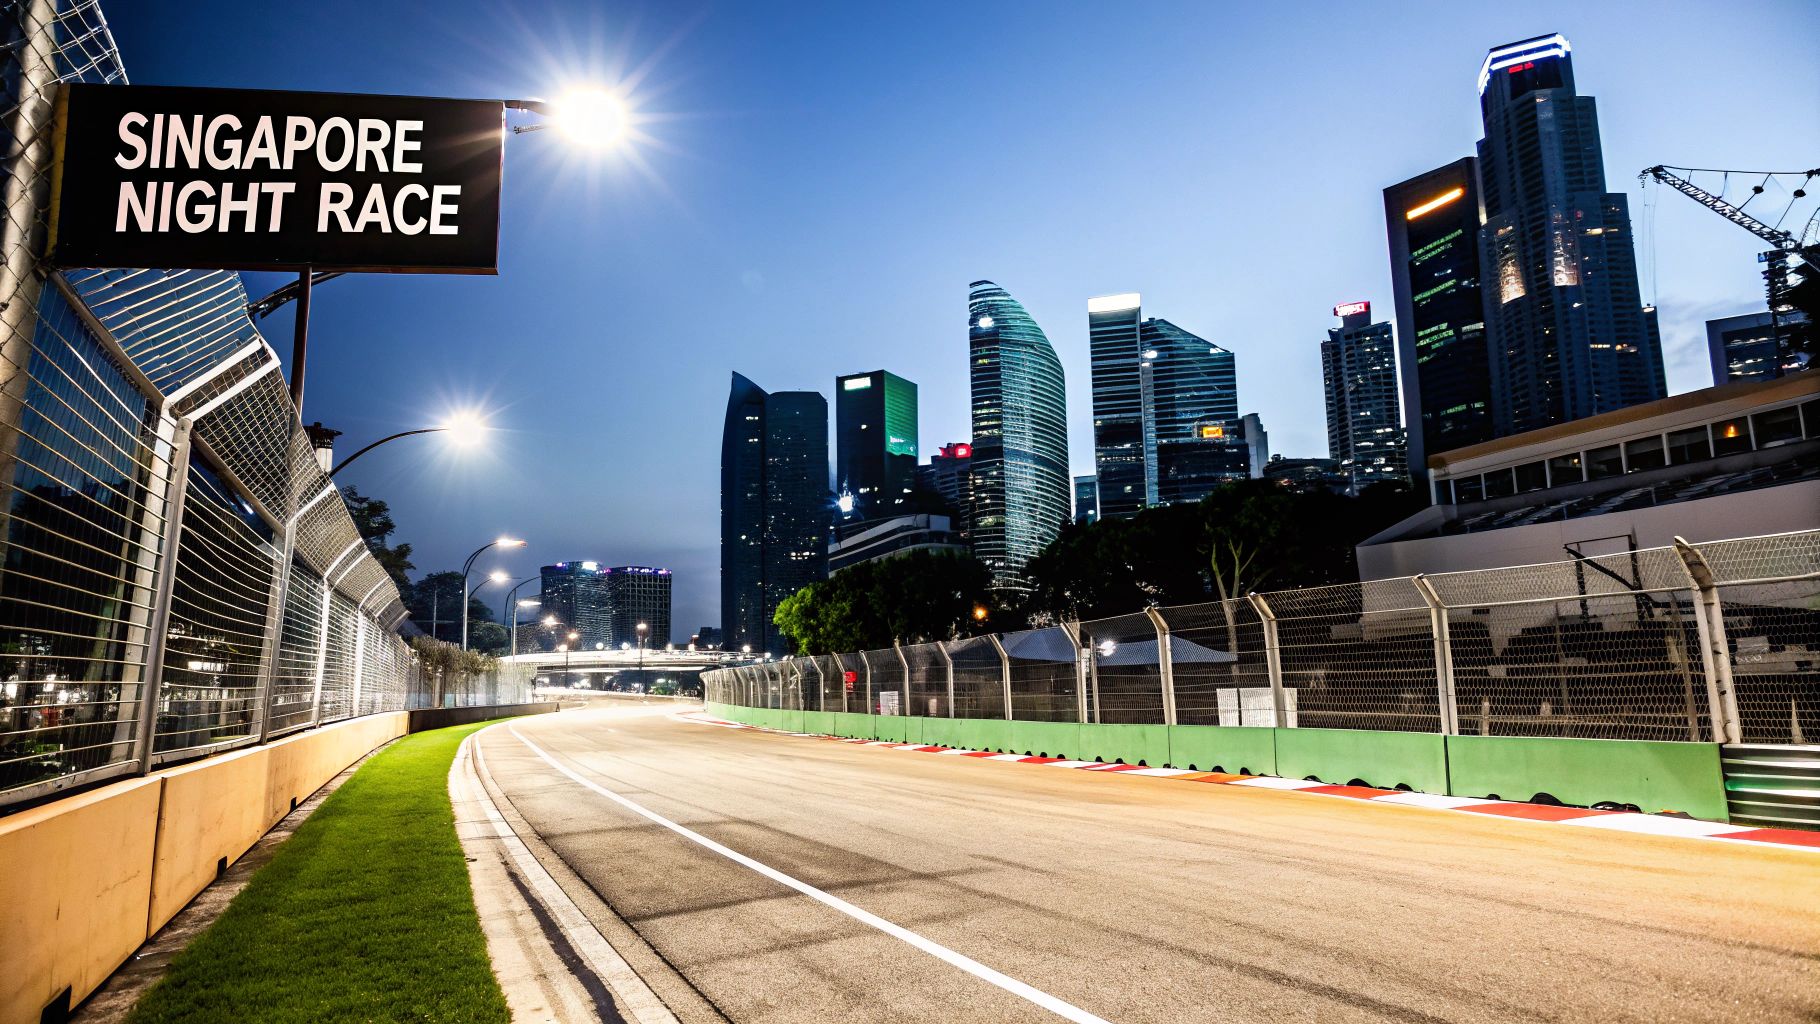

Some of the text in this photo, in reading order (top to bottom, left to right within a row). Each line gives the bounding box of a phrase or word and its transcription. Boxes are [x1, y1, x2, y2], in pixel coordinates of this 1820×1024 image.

[114, 111, 424, 174] SINGAPORE
[116, 180, 462, 236] NIGHT RACE
